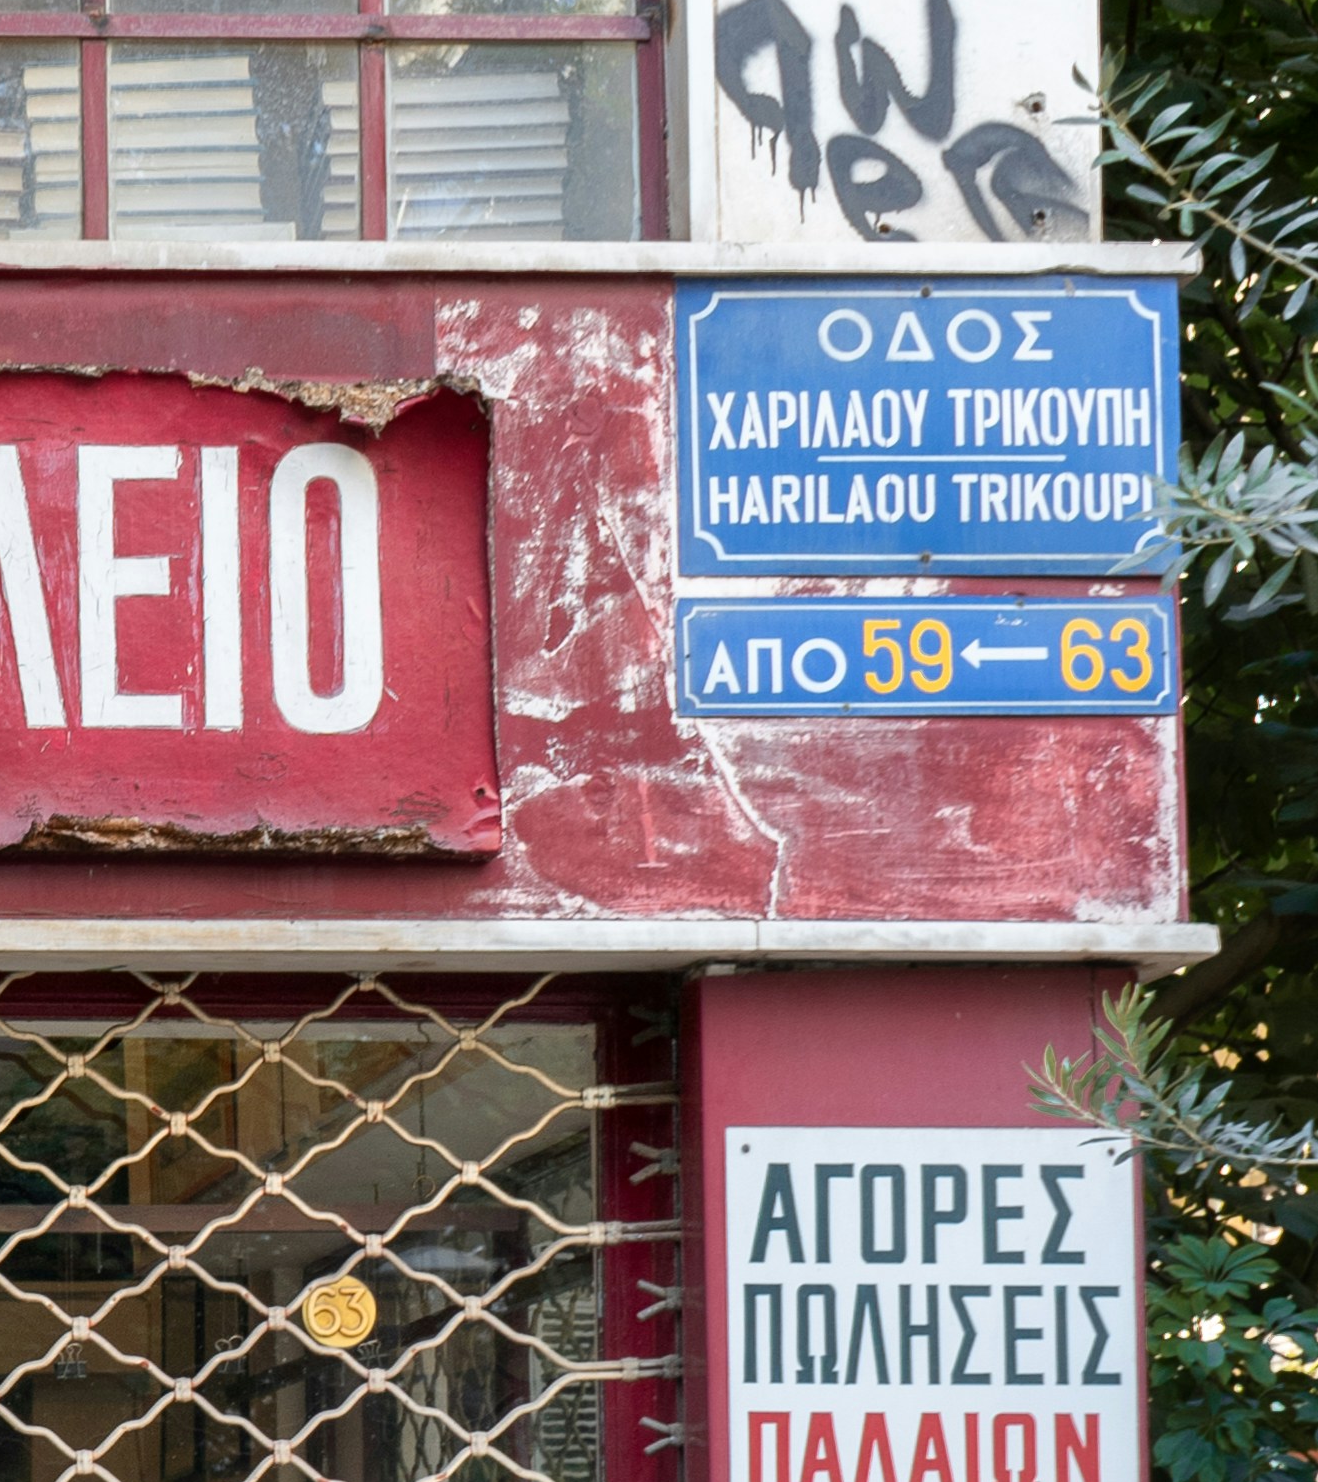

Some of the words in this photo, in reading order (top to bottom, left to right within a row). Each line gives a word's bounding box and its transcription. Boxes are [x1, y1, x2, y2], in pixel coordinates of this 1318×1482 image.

[818, 308, 1053, 363] ΟΔΟΣ
[706, 389, 930, 451] ΧΑΡΙΛΑΟΥ
[947, 387, 1152, 449] ΤΡΙΚΟΥΠΗ
[708, 474, 936, 525] HARILAOU
[952, 472, 1154, 523] TRIKOUPI
[702, 637, 848, 695] ΑΠΟ
[862, 619, 954, 694] 59
[1060, 618, 1154, 693] 63
[748, 1162, 1086, 1265] ΑΓΟΡΕΣ
[307, 1284, 372, 1338] 63
[742, 1283, 1122, 1386] ΠΩΛΗΣΕΙΣ
